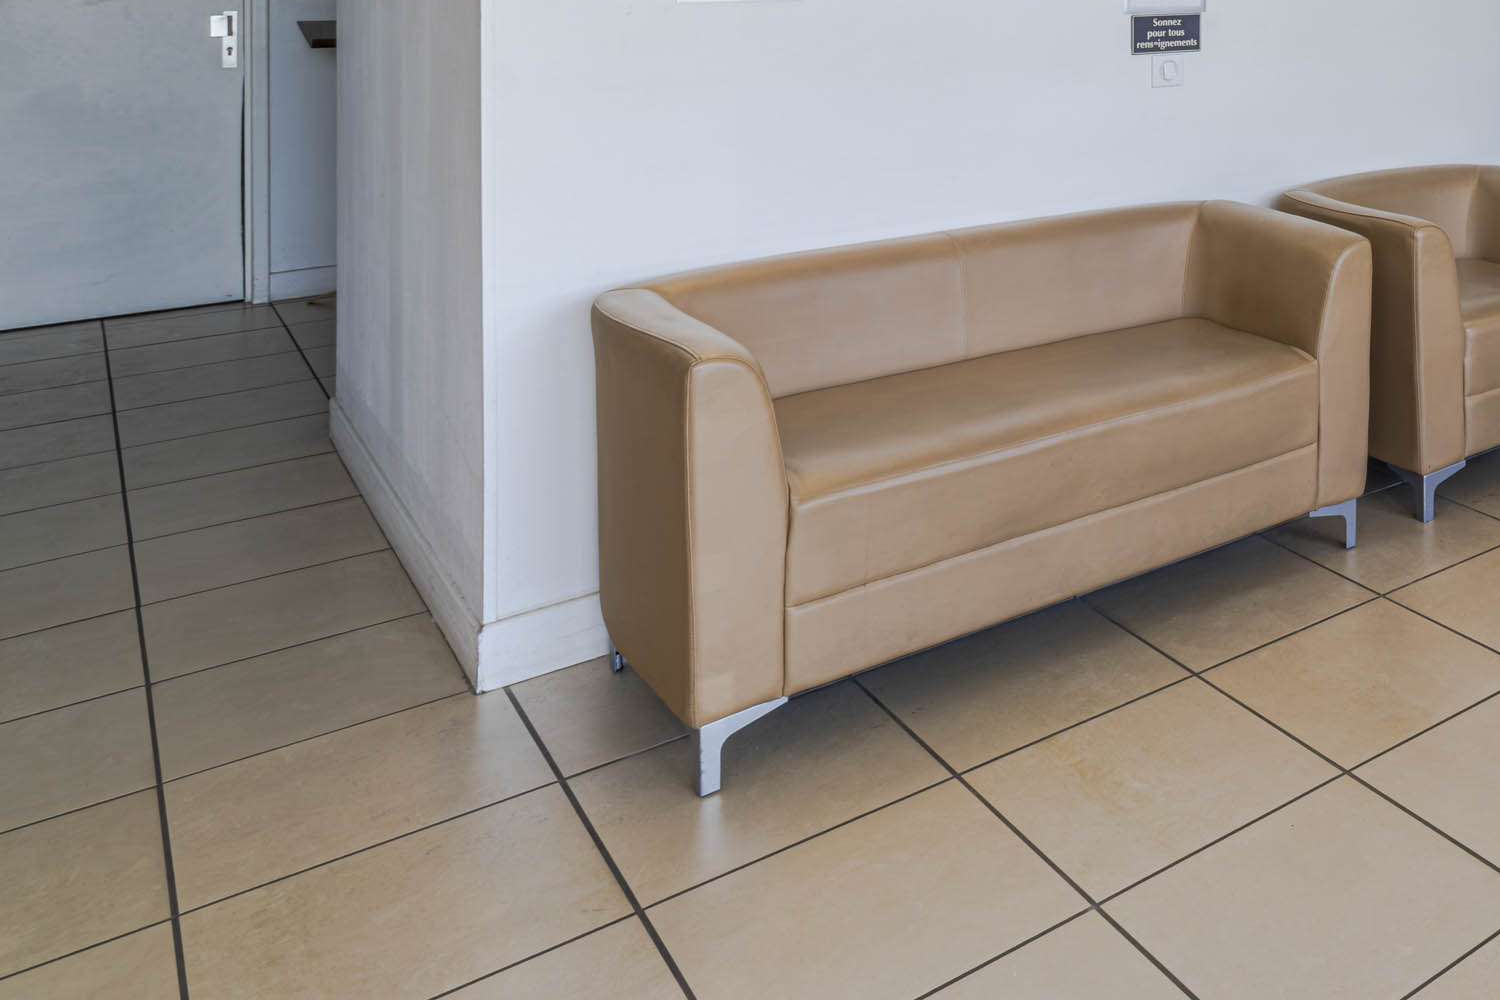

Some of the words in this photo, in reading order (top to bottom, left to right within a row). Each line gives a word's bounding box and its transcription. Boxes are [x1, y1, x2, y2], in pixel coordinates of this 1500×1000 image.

[1153, 18, 1182, 27] Sonnez
[1147, 29, 1166, 40] pour
[1168, 29, 1185, 37] tous
